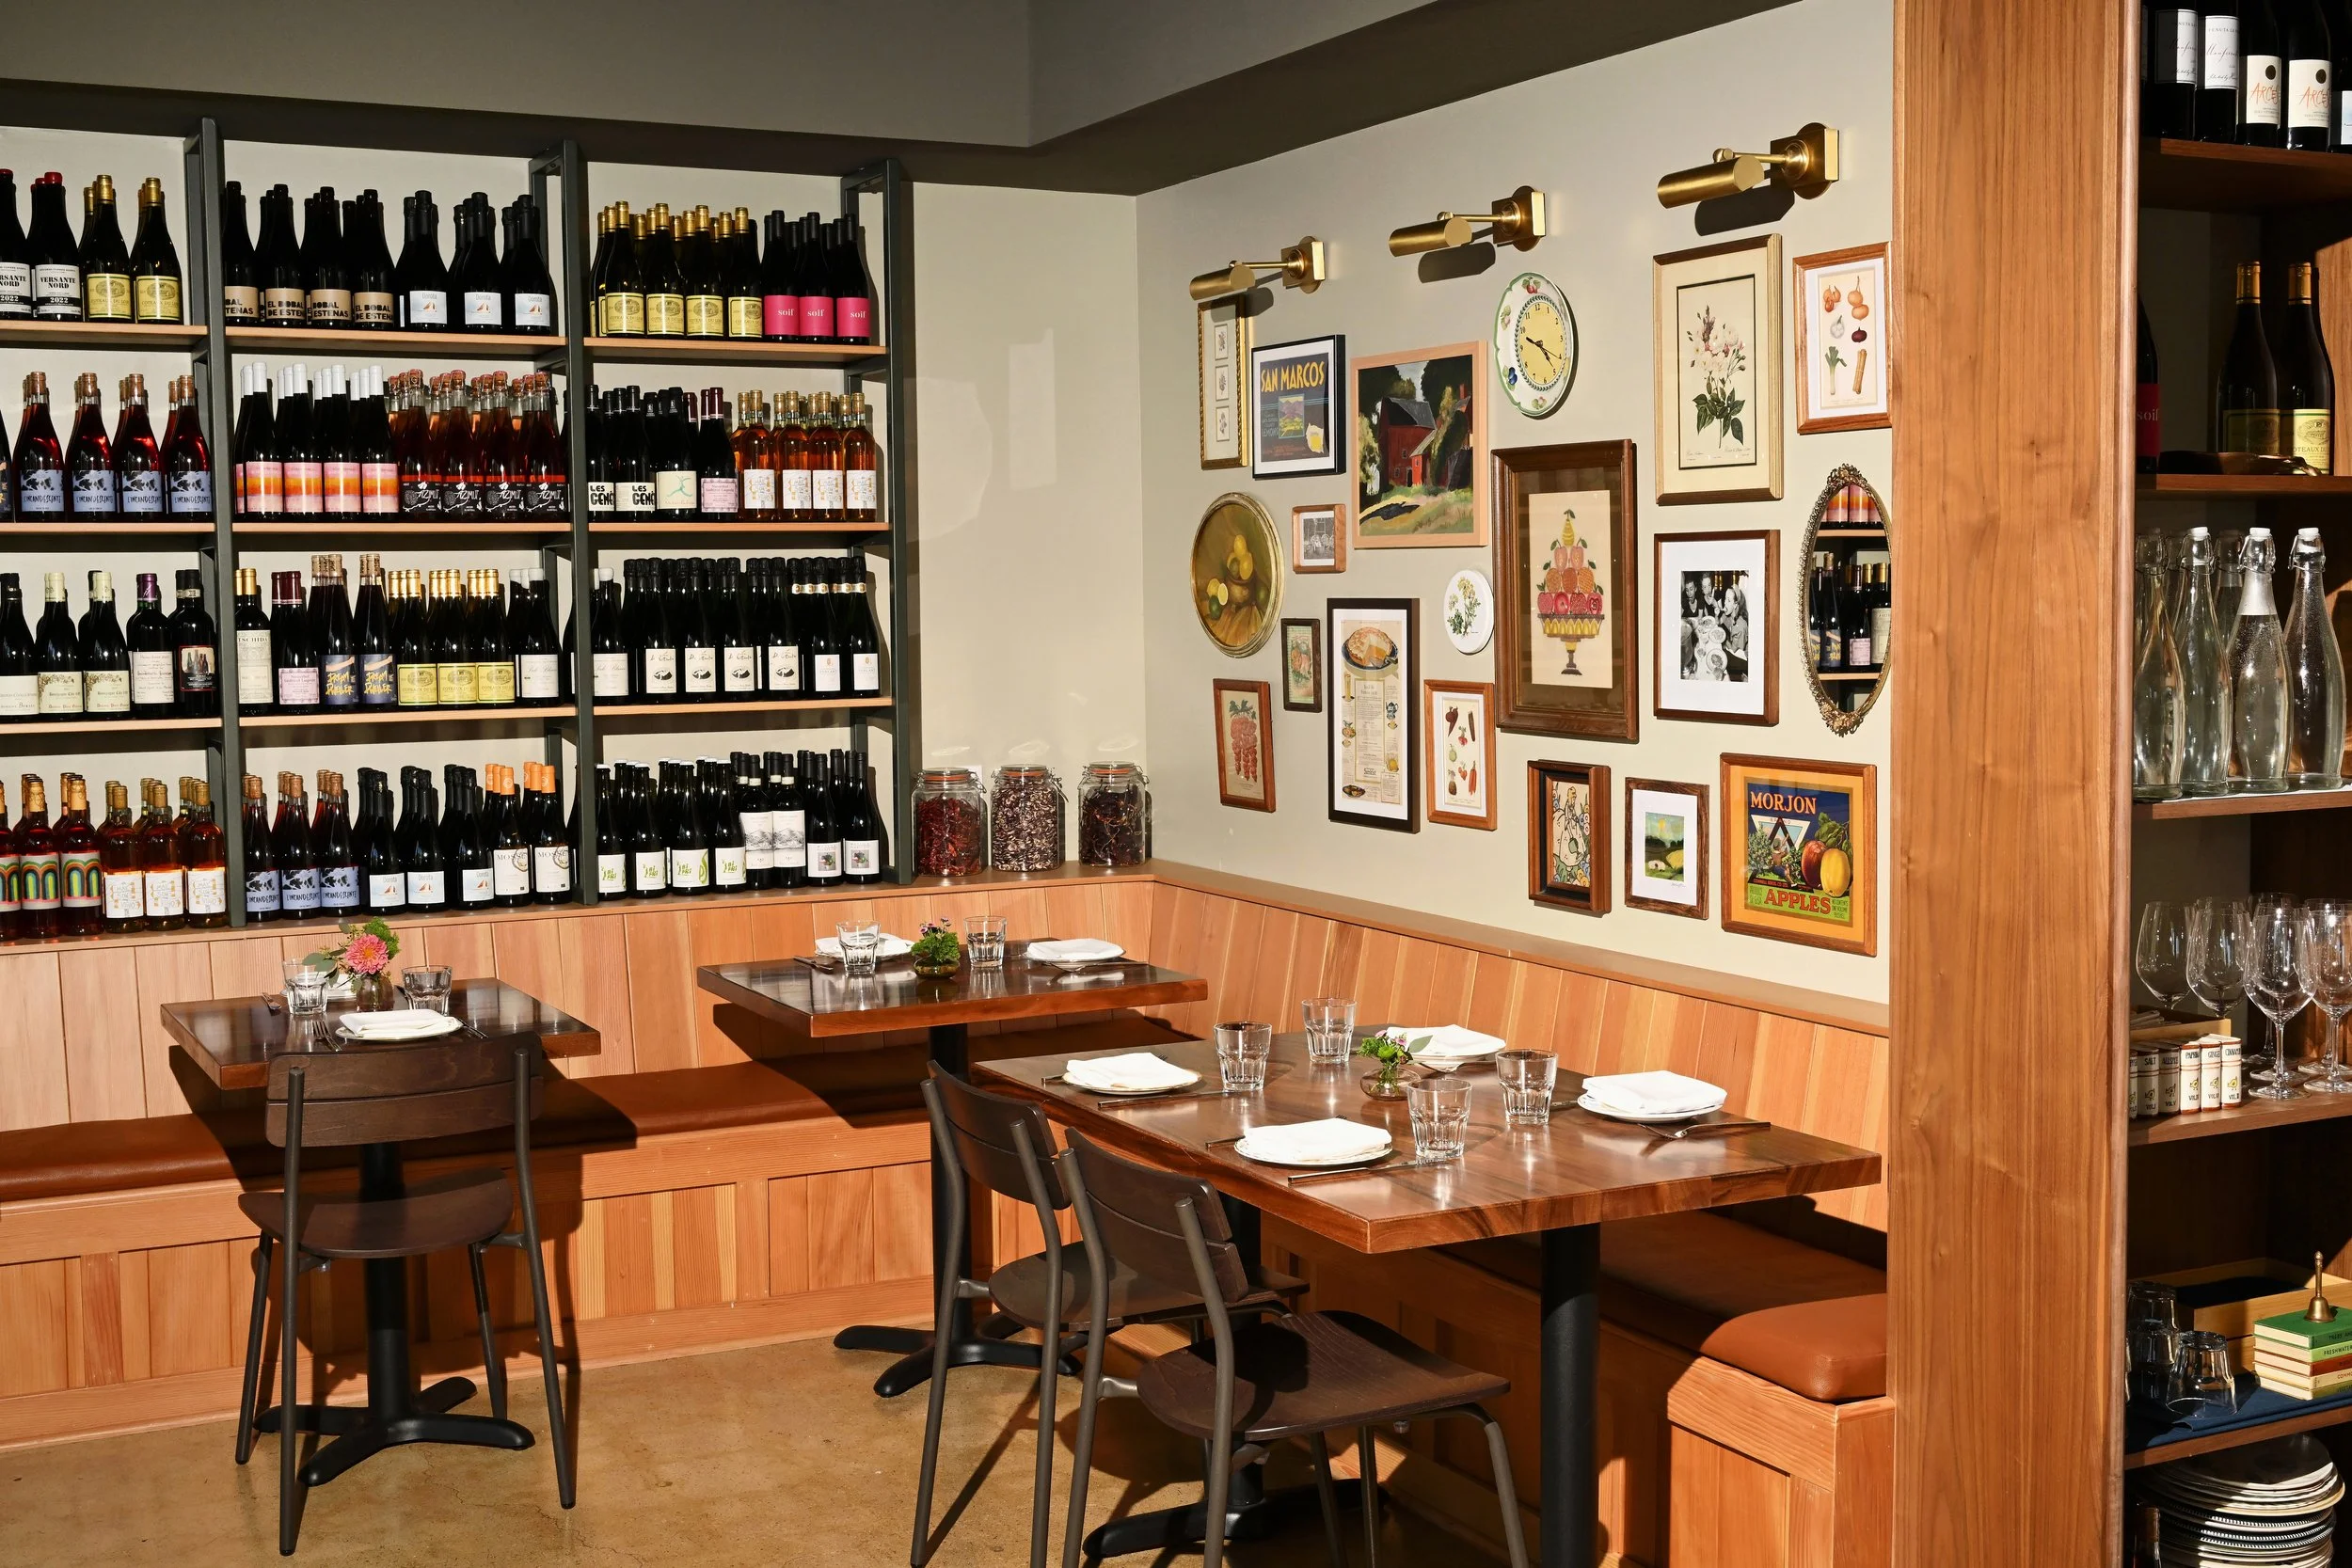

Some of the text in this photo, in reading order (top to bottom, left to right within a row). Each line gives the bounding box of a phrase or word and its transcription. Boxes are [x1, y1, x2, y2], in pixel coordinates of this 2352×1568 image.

[278, 301, 305, 309] BOBAL
[1534, 303, 1541, 311] 12
[807, 309, 825, 317] soif
[850, 310, 866, 319] soif
[1525, 311, 1531, 320] 11
[1520, 325, 1526, 334] 10
[1261, 360, 1325, 393] SAN MARCOS
[1552, 368, 1556, 376] 5
[1750, 791, 1817, 816] MORJON
[1764, 888, 1832, 915] APPLES
[2145, 1057, 2156, 1066] SALT
